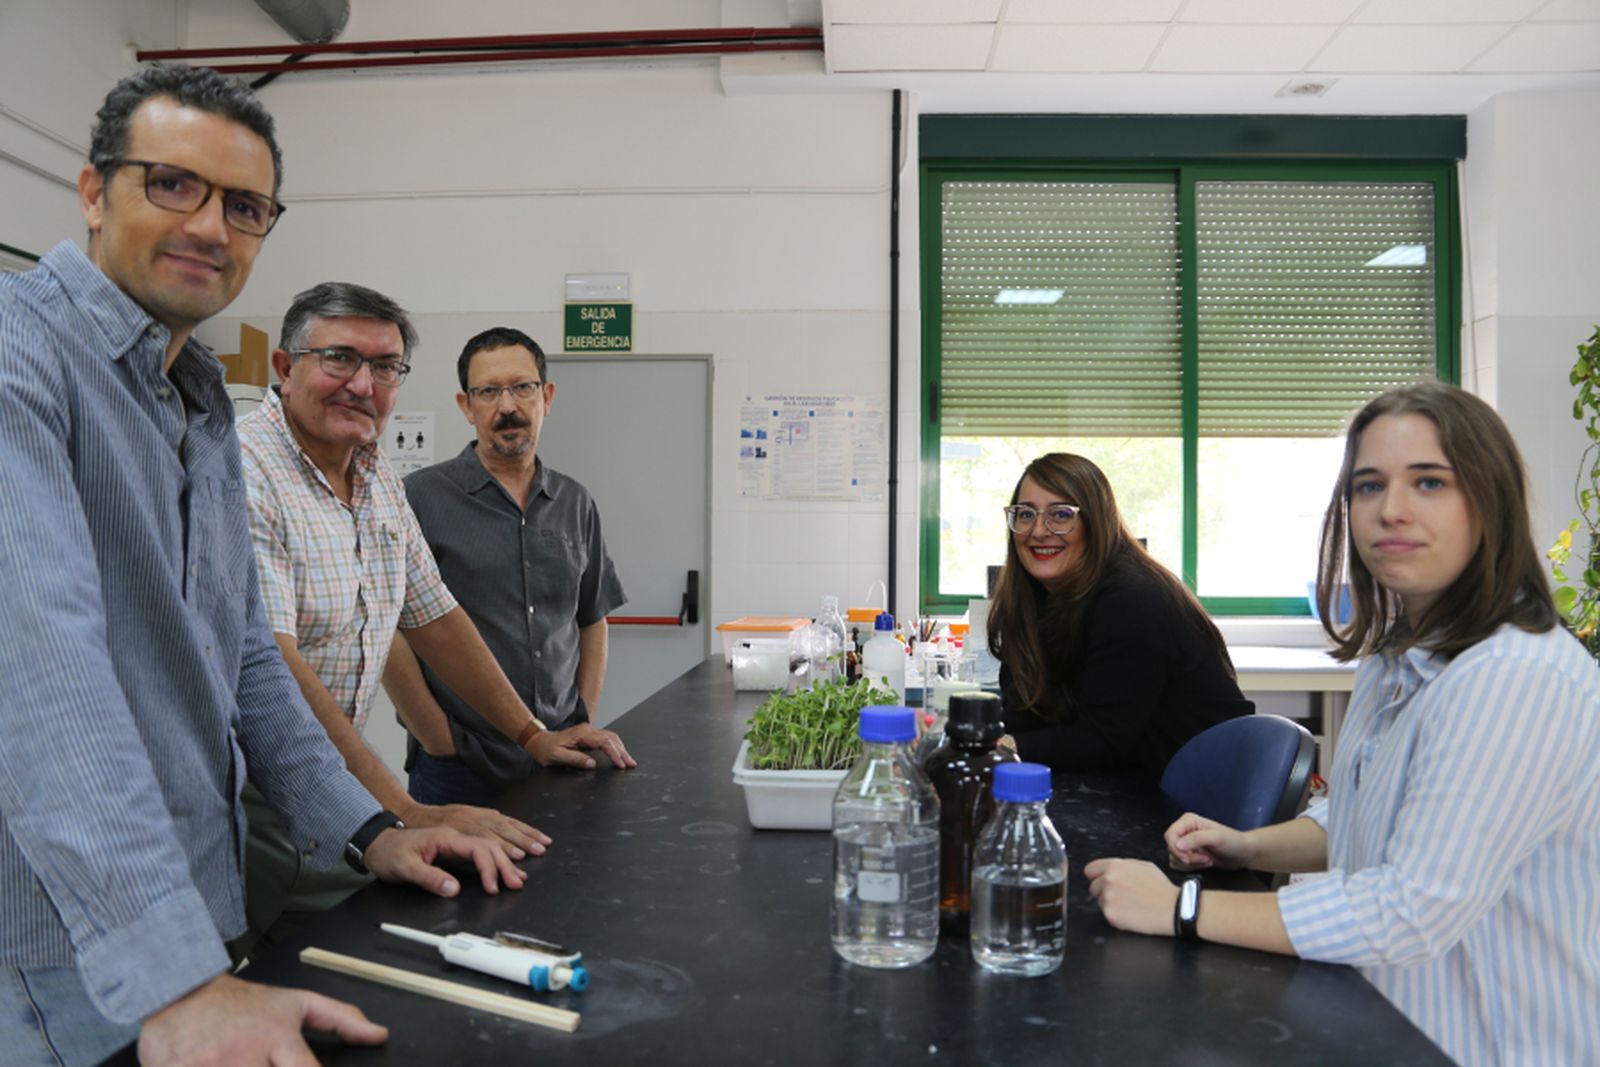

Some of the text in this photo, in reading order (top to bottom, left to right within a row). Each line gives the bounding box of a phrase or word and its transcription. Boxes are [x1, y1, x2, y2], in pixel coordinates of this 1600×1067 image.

[580, 307, 616, 320] SALIDA
[591, 321, 605, 334] DE
[566, 335, 630, 348] EMERGENCIA
